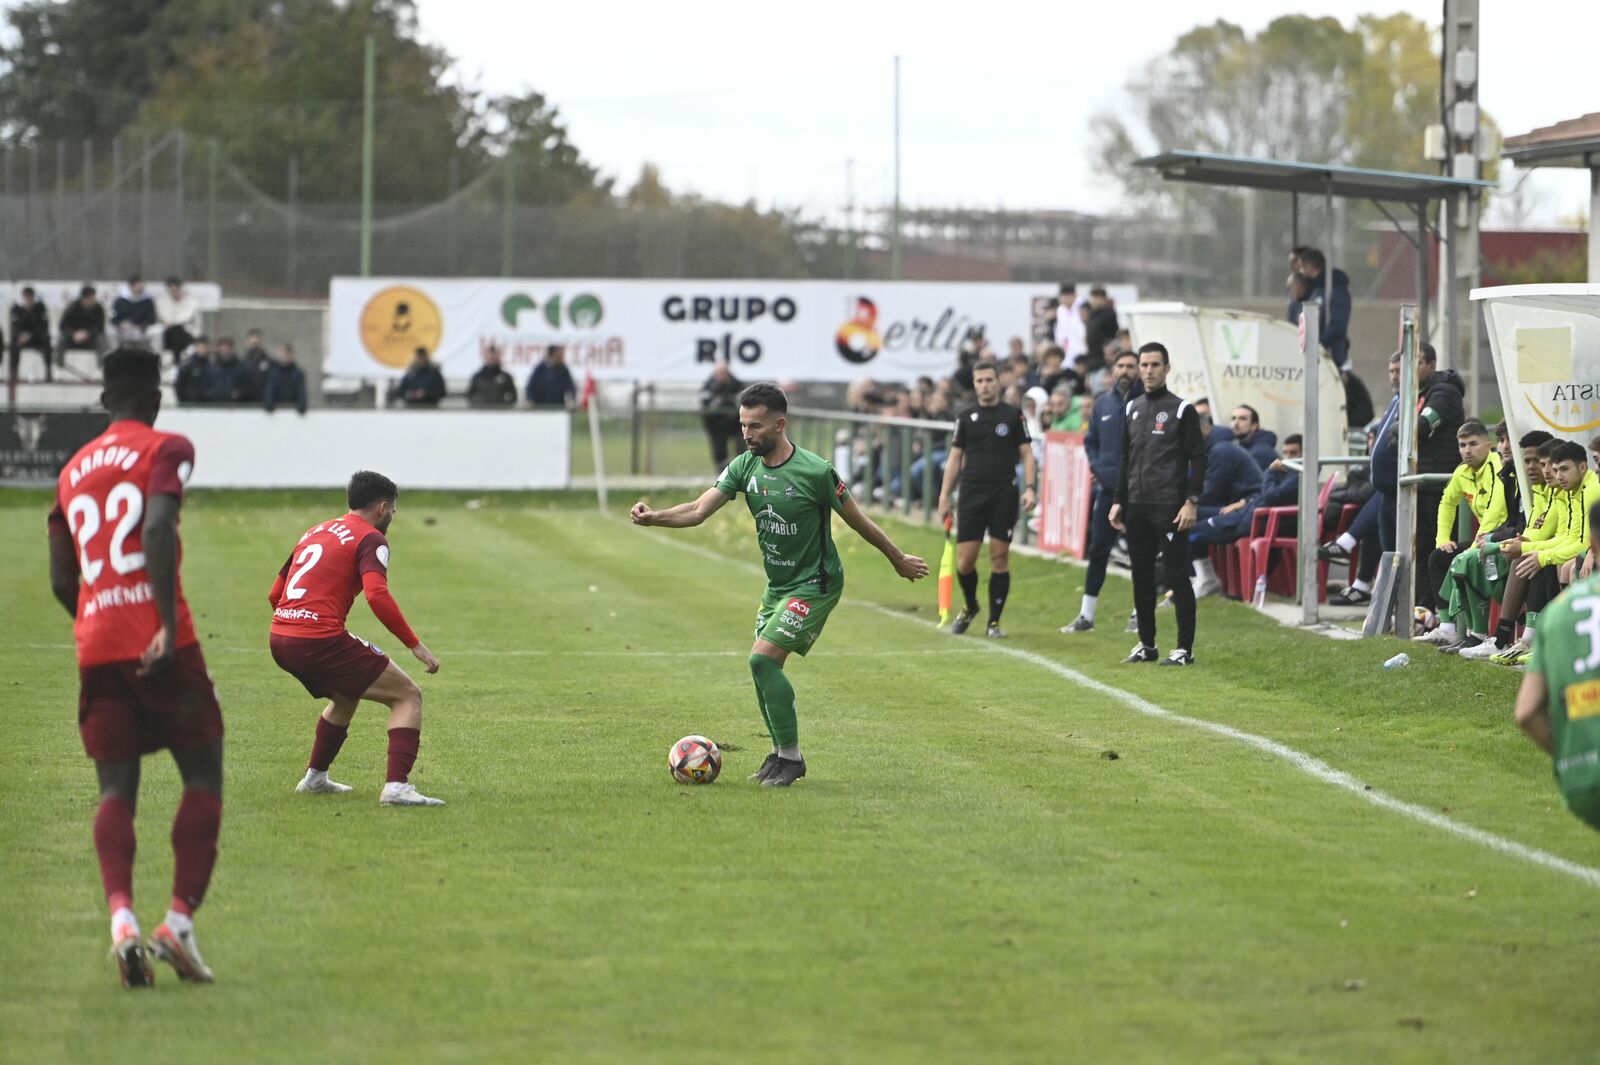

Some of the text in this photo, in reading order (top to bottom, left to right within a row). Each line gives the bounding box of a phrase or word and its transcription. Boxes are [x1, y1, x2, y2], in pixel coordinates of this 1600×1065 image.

[662, 295, 797, 322] GRUPO
[694, 333, 762, 364] RÍO
[70, 445, 140, 488] ARROYO
[67, 481, 146, 586] 22
[286, 543, 323, 600] 2
